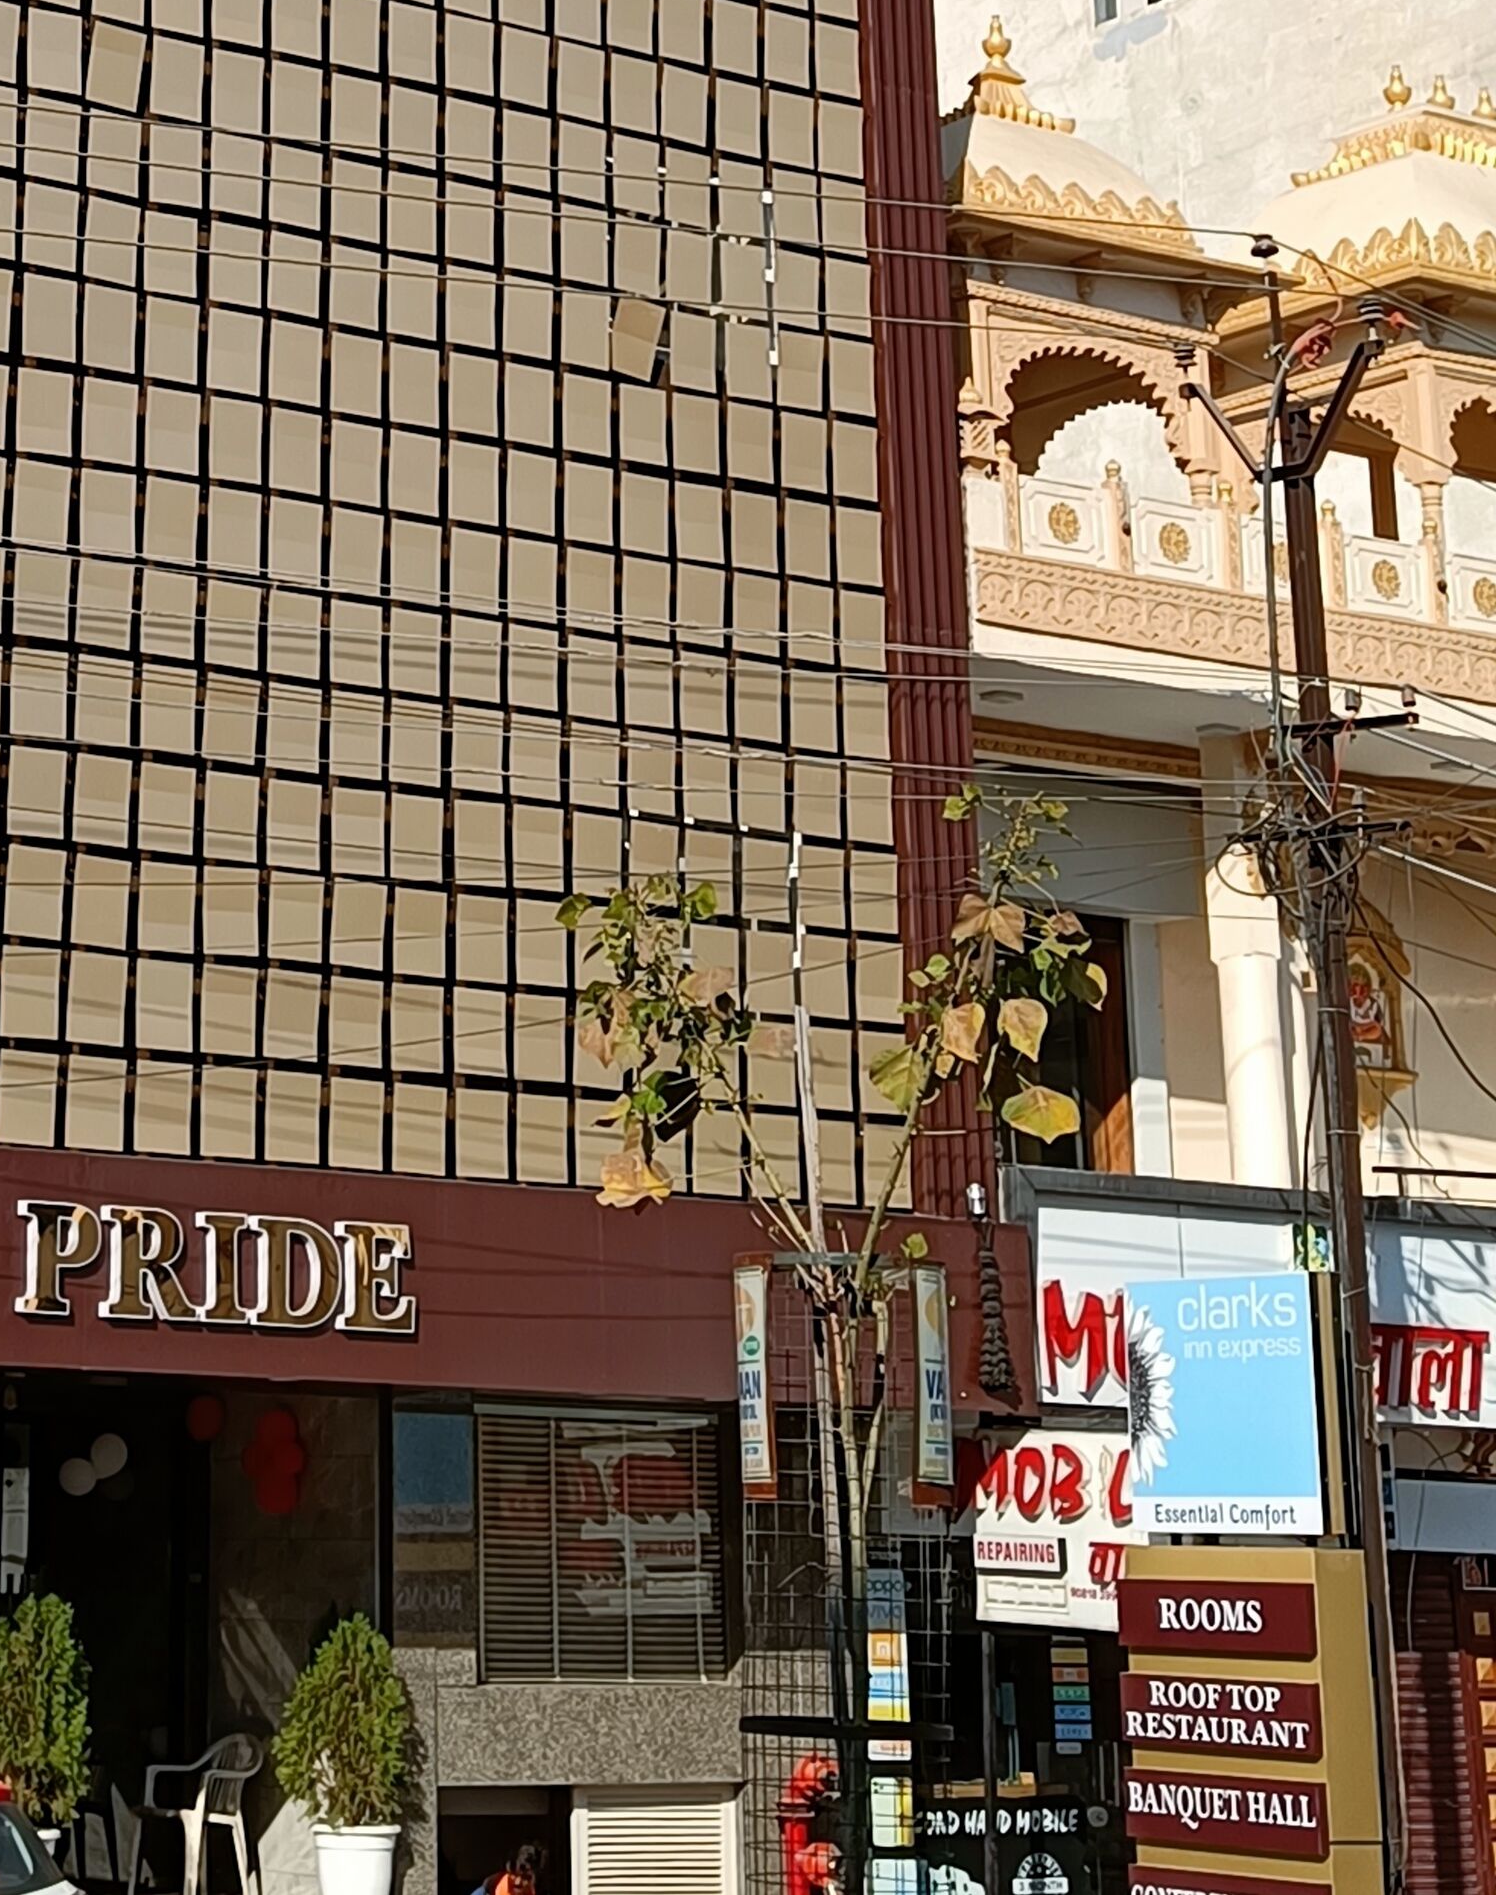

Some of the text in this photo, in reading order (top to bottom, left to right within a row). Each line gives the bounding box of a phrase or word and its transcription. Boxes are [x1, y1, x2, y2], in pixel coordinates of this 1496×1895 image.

[14, 1198, 417, 1335] PRIDE
[1177, 1280, 1298, 1331] clarks
[1184, 1336, 1302, 1363] inn express
[1154, 1502, 1298, 1532] Essential Comfort
[976, 1540, 1056, 1564] REPAIRING
[1158, 1597, 1263, 1633] ROOMS
[1149, 1680, 1281, 1713] ROOF TOP
[1126, 1710, 1310, 1749] RESTAURANT
[1015, 1807, 1079, 1836] MOBILE
[1127, 1781, 1317, 1830] BANQUET HALL
